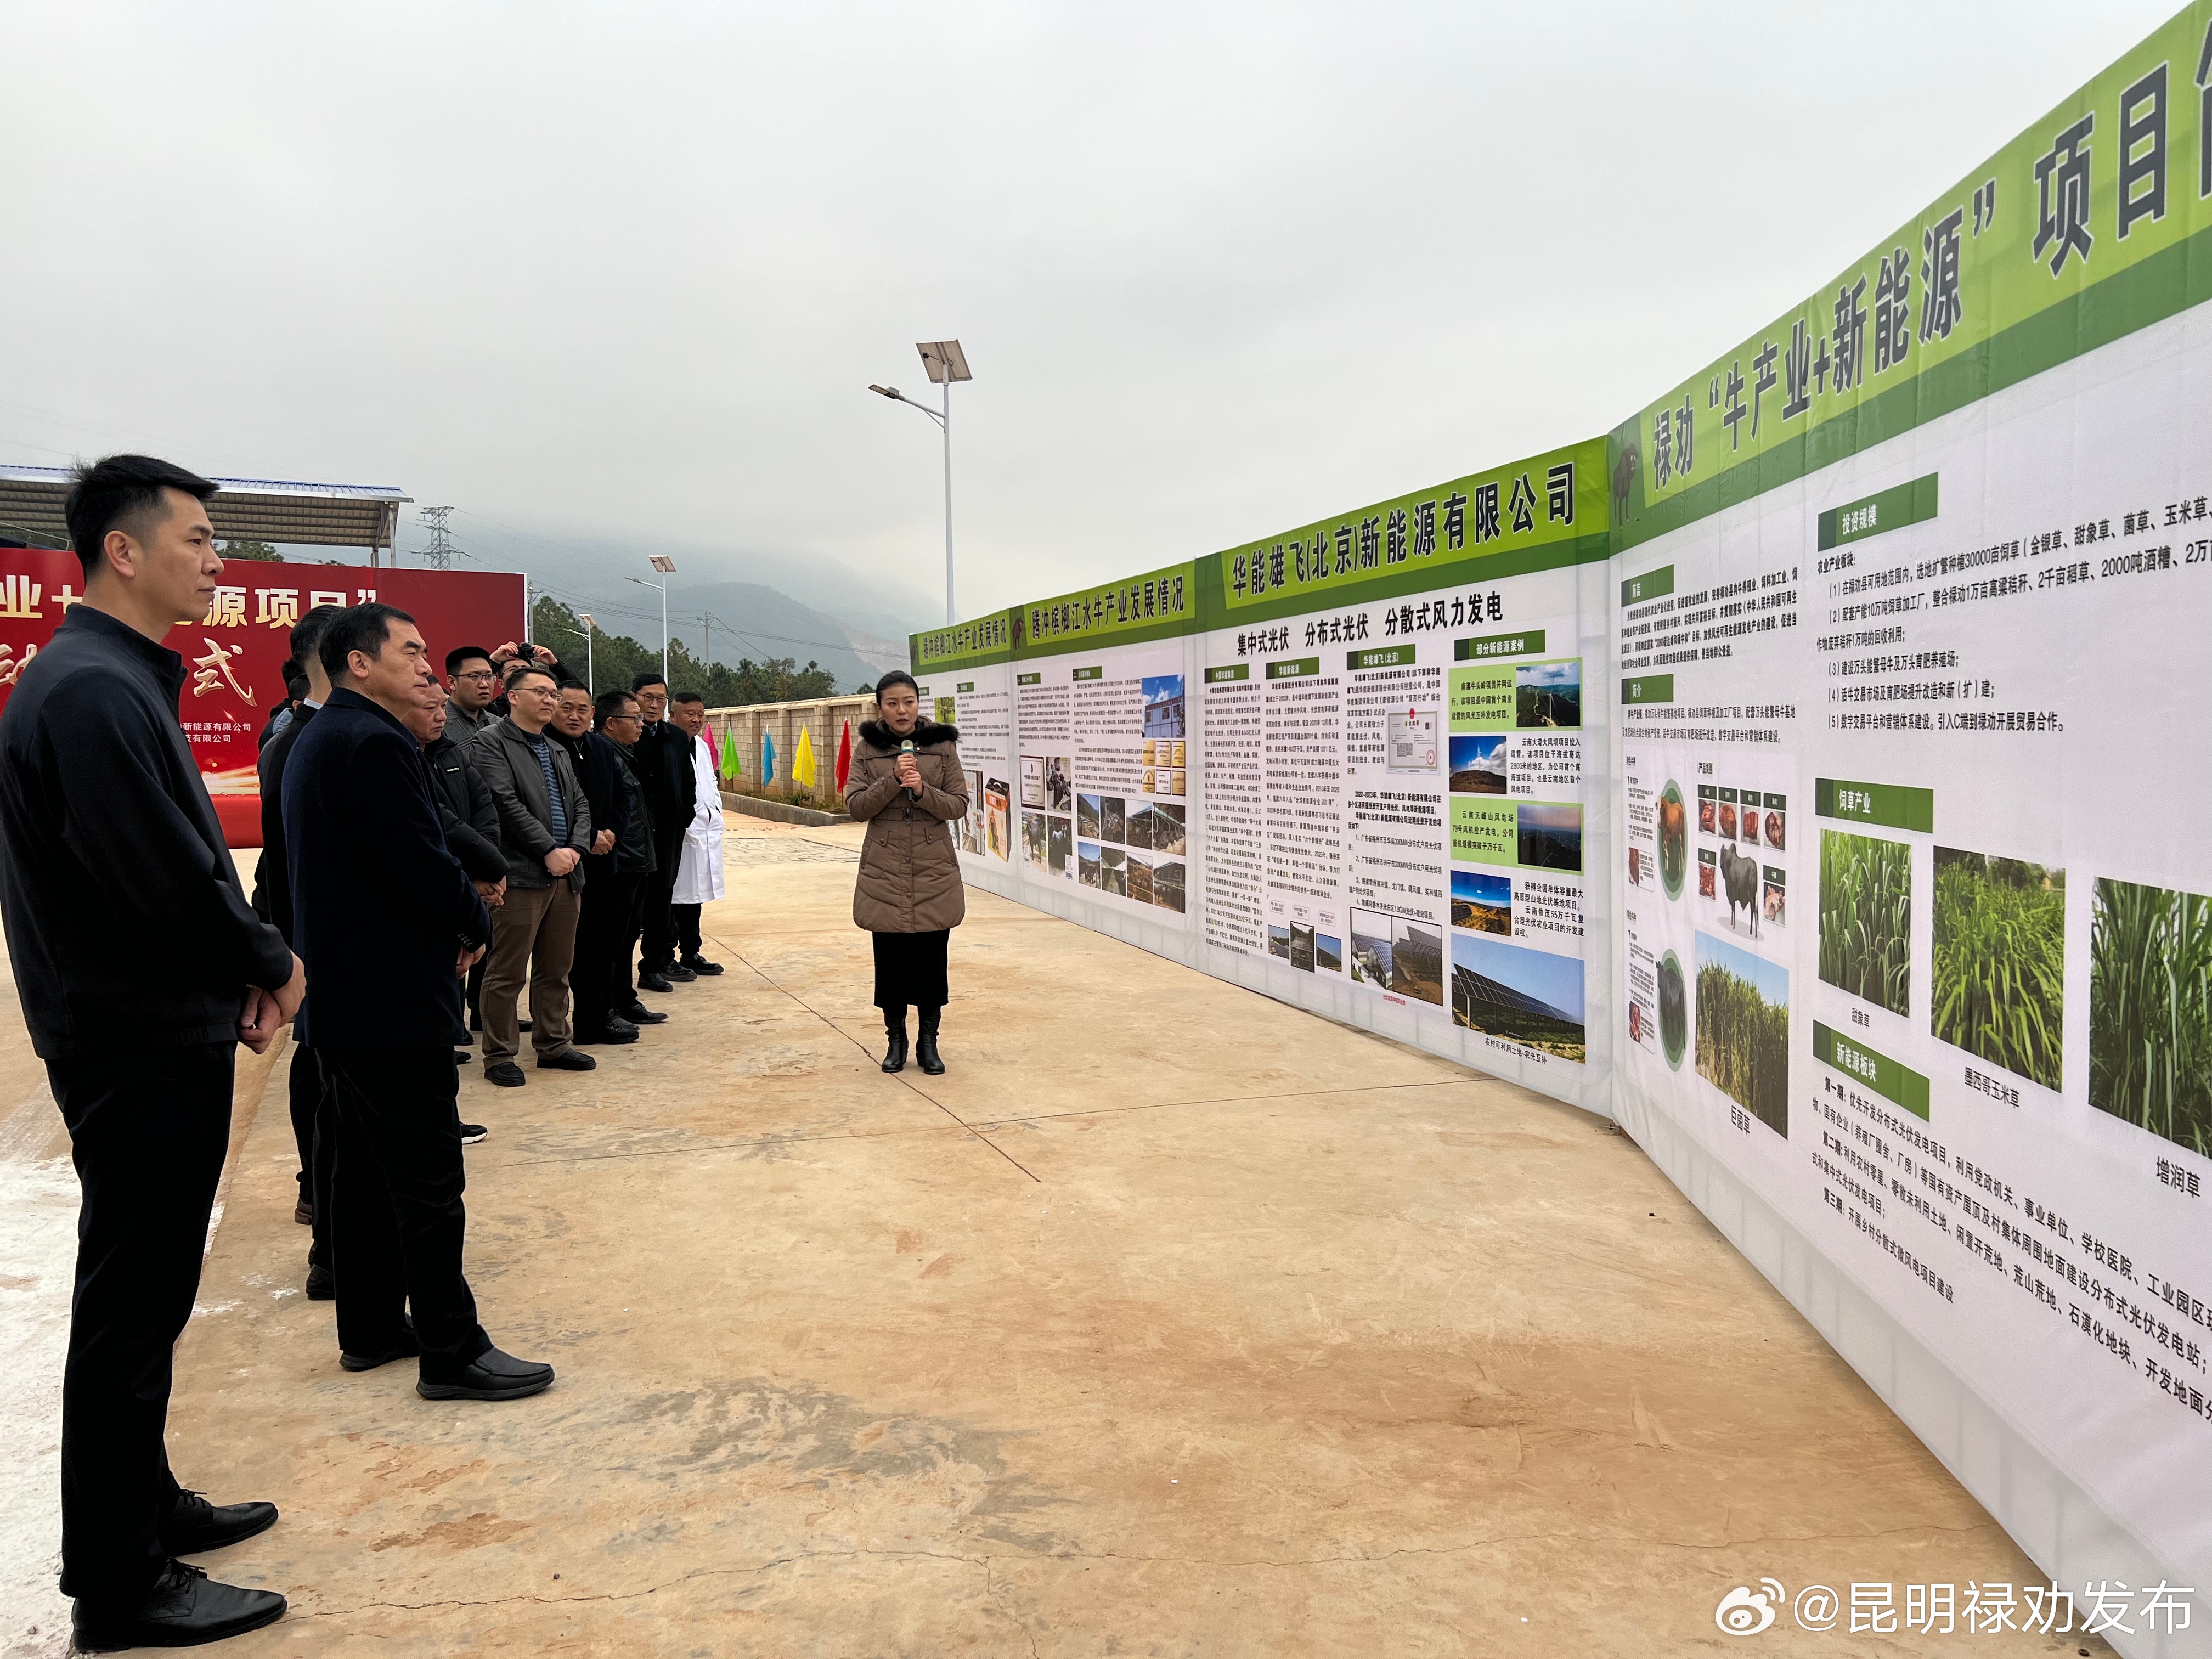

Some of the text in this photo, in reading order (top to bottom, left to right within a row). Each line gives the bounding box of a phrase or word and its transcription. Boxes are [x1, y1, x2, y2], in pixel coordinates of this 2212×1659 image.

[1842, 504, 1877, 535] 投资规模
[1237, 590, 1503, 657] 集中式光伏 分布式光伏 分散式风力发电
[1476, 639, 1525, 656] 部分新能源案例
[193, 637, 257, 707] 式
[1279, 664, 1299, 675] 华能新能源
[1461, 679, 1512, 691] 南澳牛头岭项目并网运
[1451, 695, 1512, 706] 行，该项目是中国首个商业
[1451, 710, 1510, 720] 运营的风光互补发电项目。
[180, 722, 251, 731] 新能源有限公司
[1522, 738, 1581, 747] 云南大理大风坝项目投入
[1511, 750, 1581, 759] 运营。该项目位于海拔高达
[1838, 789, 1871, 815] 饲草产业
[1462, 811, 1514, 823] 云南天峰山风电场
[1525, 882, 1584, 899] 获得全国单体容量最大
[1514, 891, 1581, 911] 高原型山地光伏基地项目。
[1525, 905, 1584, 924] 云南物茂55万千瓦复
[1514, 916, 1584, 936] 合型光伏农业项目的开发建
[1514, 928, 1529, 938] 设权。
[1852, 1007, 1870, 1029] 甜象草
[1836, 1041, 1877, 1082] 新能源板块
[1965, 1066, 2020, 1109] 墨西哥玉米草
[1730, 1105, 1751, 1135] 巨菌草
[2155, 1156, 2201, 1198] 增润草
